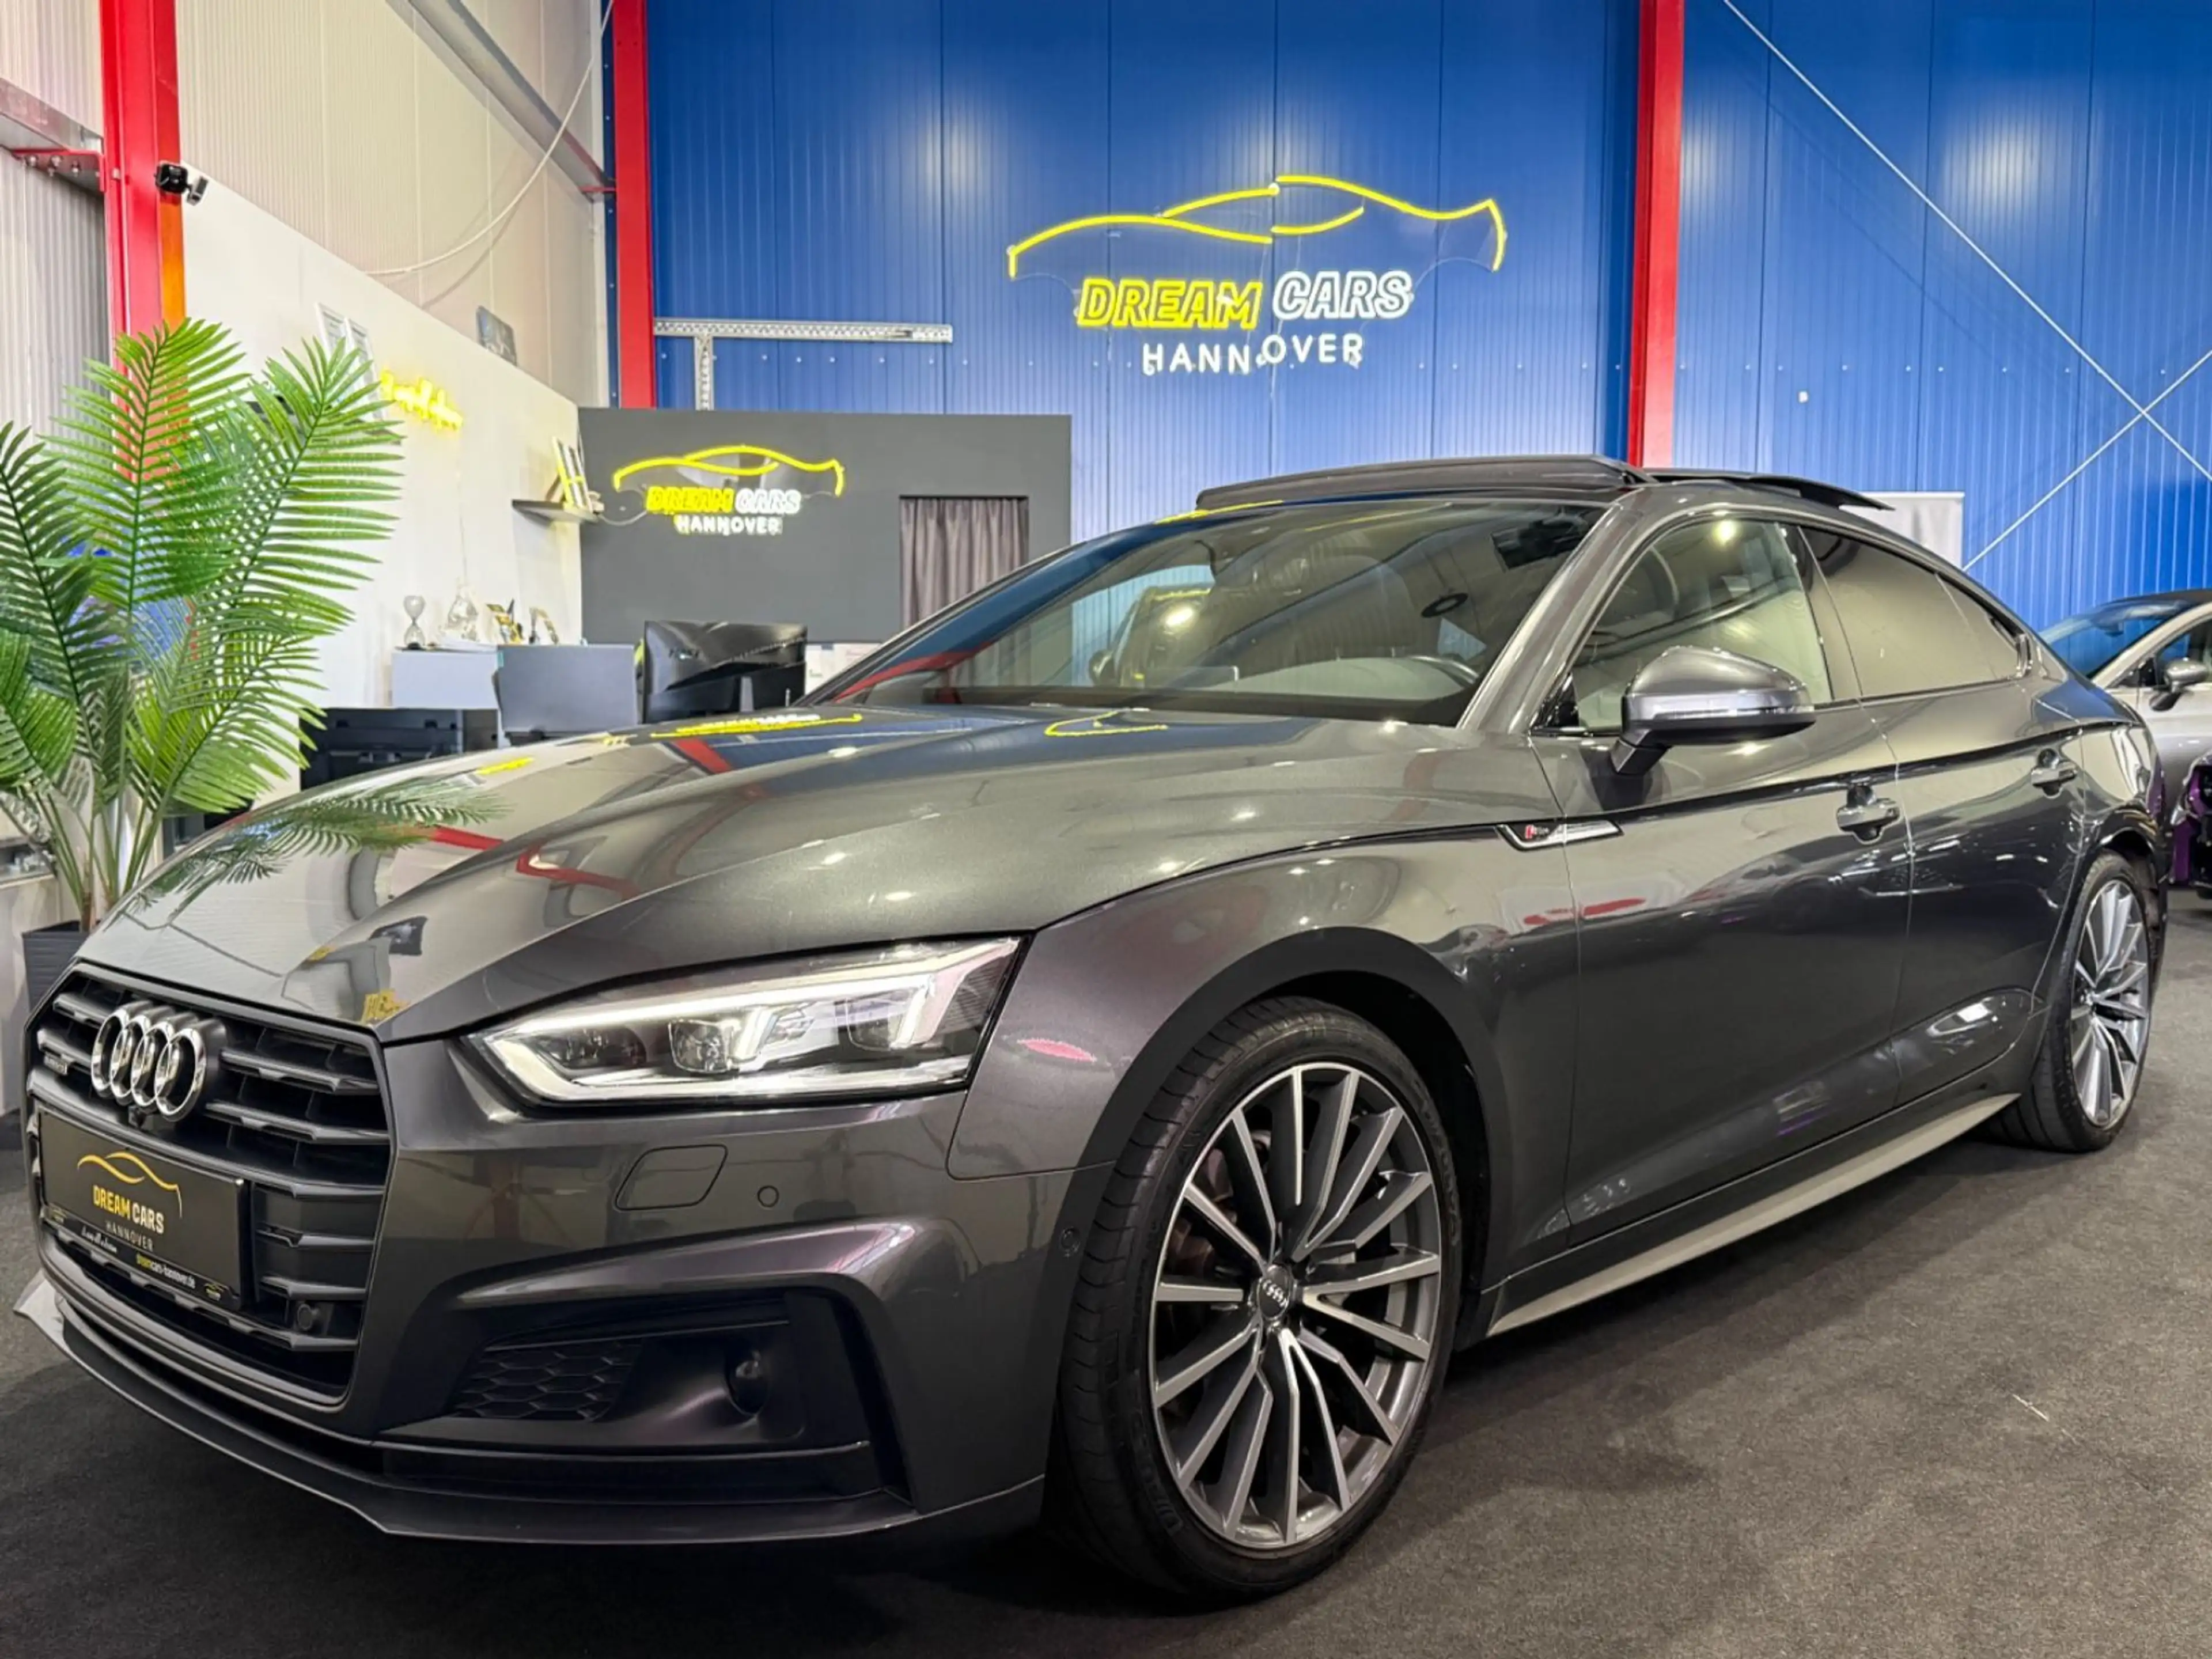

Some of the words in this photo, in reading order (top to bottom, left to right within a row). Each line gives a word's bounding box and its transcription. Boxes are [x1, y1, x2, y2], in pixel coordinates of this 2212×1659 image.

[1076, 277, 1263, 329] DREAM
[1272, 271, 1413, 320] CARS
[1142, 333, 1363, 376] HANNOVER
[646, 486, 734, 512] DREAM
[735, 488, 802, 514] CARS
[673, 514, 783, 536] HANNOVER
[93, 1184, 131, 1221] DREAM
[132, 1202, 164, 1234] CARS
